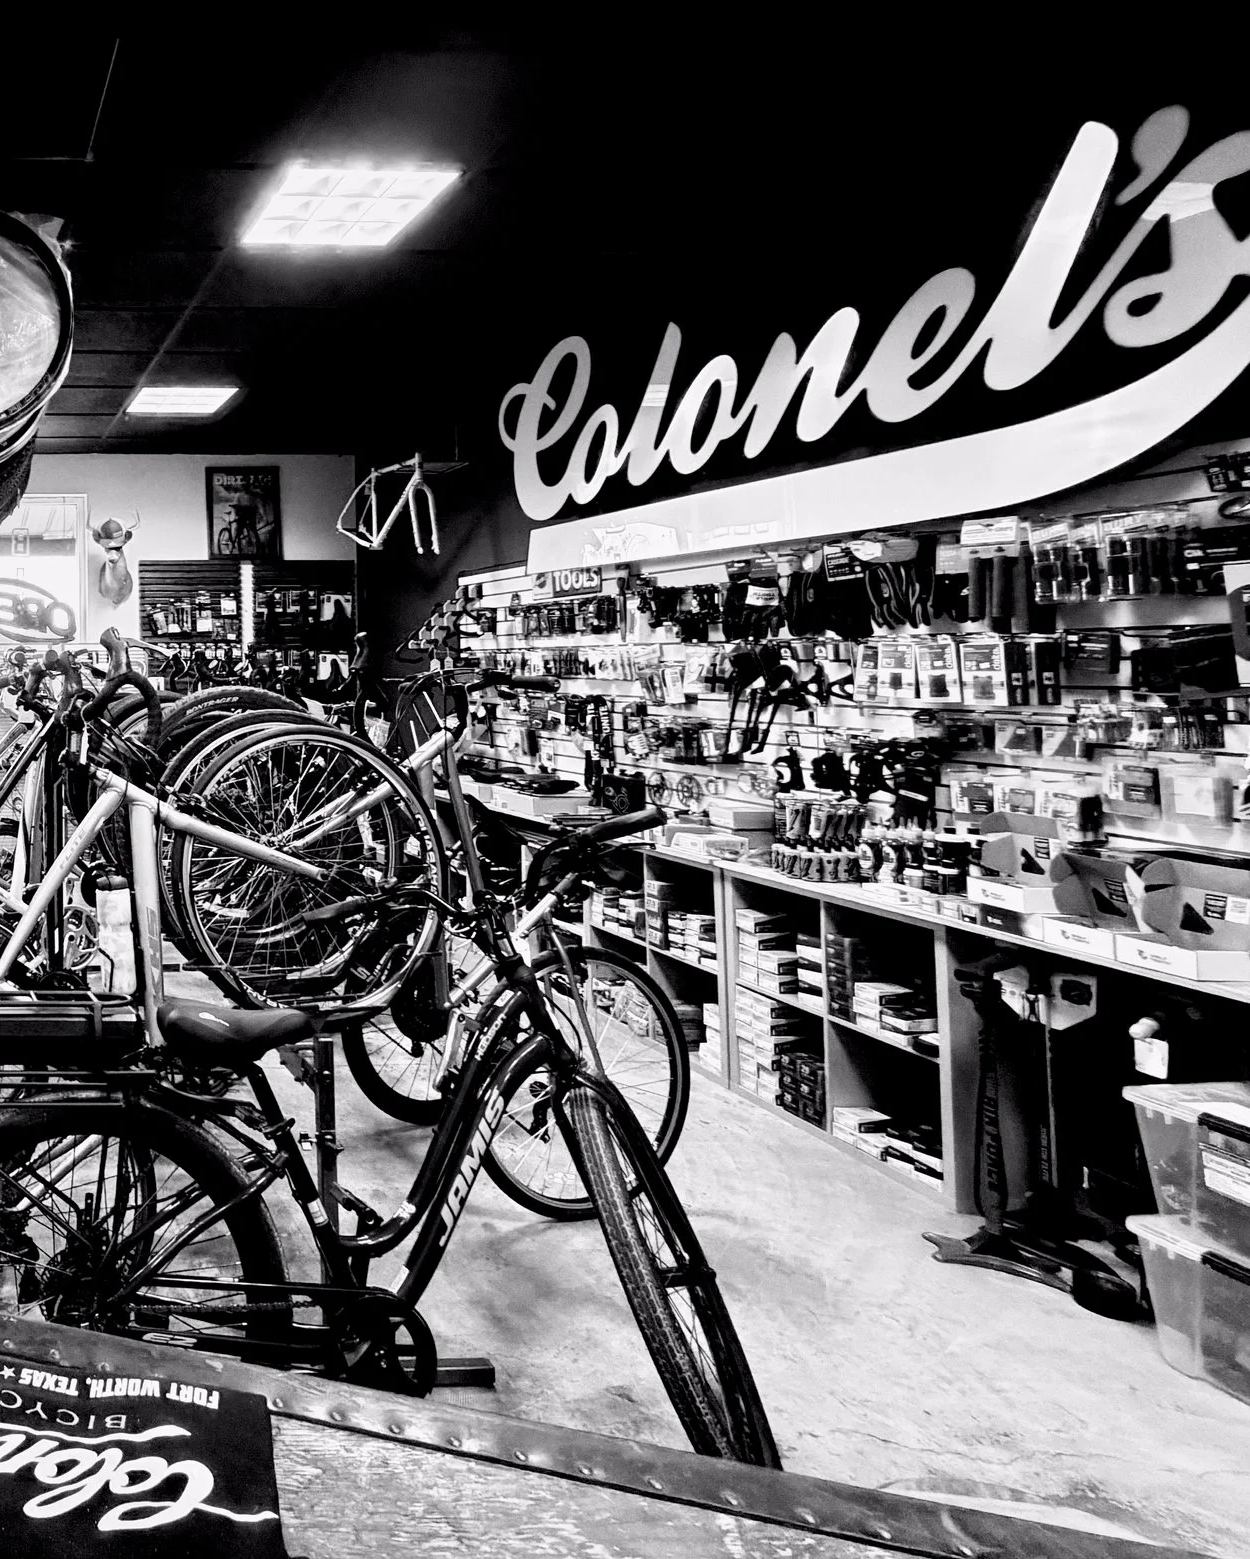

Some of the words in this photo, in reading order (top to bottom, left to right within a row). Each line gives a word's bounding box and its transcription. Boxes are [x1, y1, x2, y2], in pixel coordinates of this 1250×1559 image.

[498, 104, 1250, 521] Colonel's
[552, 567, 600, 592] TOOLS
[439, 1085, 505, 1248] JAMIS
[19, 1367, 80, 1398] TEXAS
[85, 1376, 161, 1399] WORTH,
[165, 1381, 221, 1410] FORT
